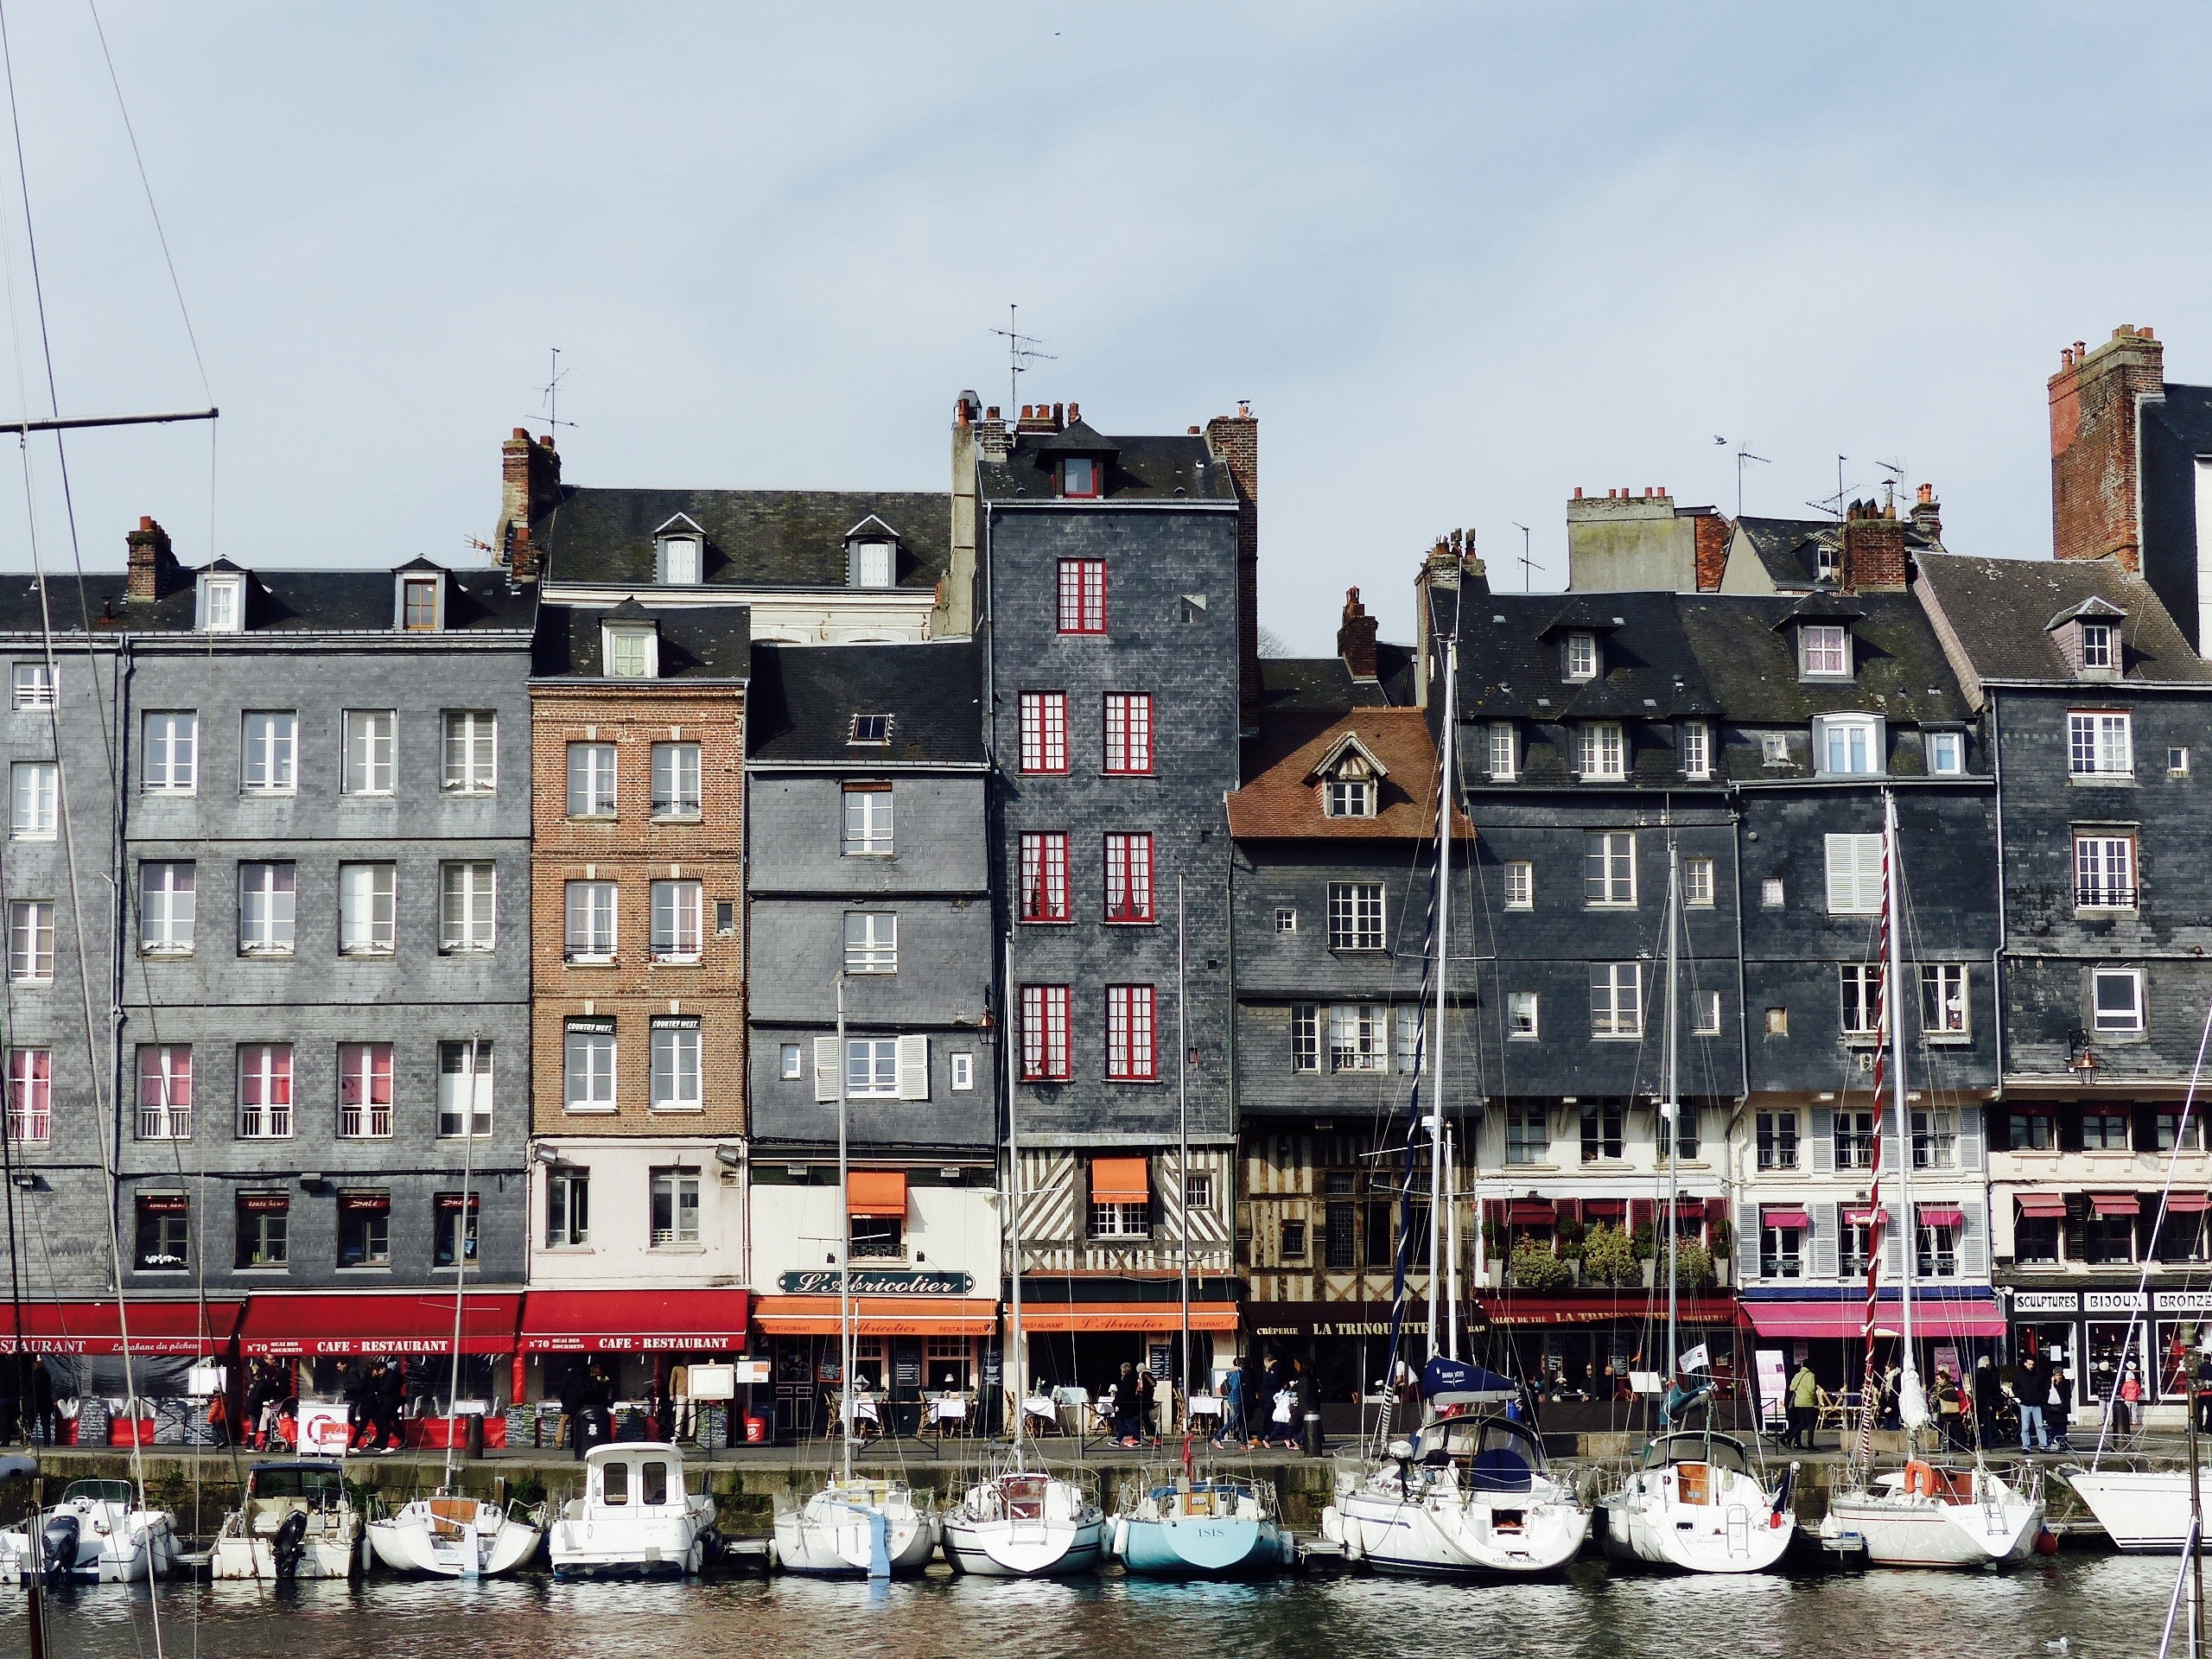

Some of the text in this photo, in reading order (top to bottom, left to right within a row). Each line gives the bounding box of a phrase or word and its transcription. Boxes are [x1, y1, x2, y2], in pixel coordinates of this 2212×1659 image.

[567, 1022, 594, 1031] COUNTRY
[794, 1272, 958, 1293] L'Abricotier
[2018, 1295, 2076, 1307] SCULPTURES
[2090, 1295, 2142, 1307] BIJOUX
[2160, 1295, 2212, 1307] BRONZE
[1489, 1316, 1515, 1325] SALON
[1256, 1325, 1299, 1336] CRÊPERIE
[1313, 1322, 1429, 1335] LA TRINQUTTE
[1467, 1325, 1486, 1333] BAR
[156, 1342, 168, 1351] du
[317, 1340, 350, 1352] CAFE
[361, 1340, 448, 1352] RESTAURANT
[599, 1338, 632, 1349] CAFE
[642, 1338, 729, 1349] RESTAURANT
[1198, 1529, 1224, 1537] ISIS
